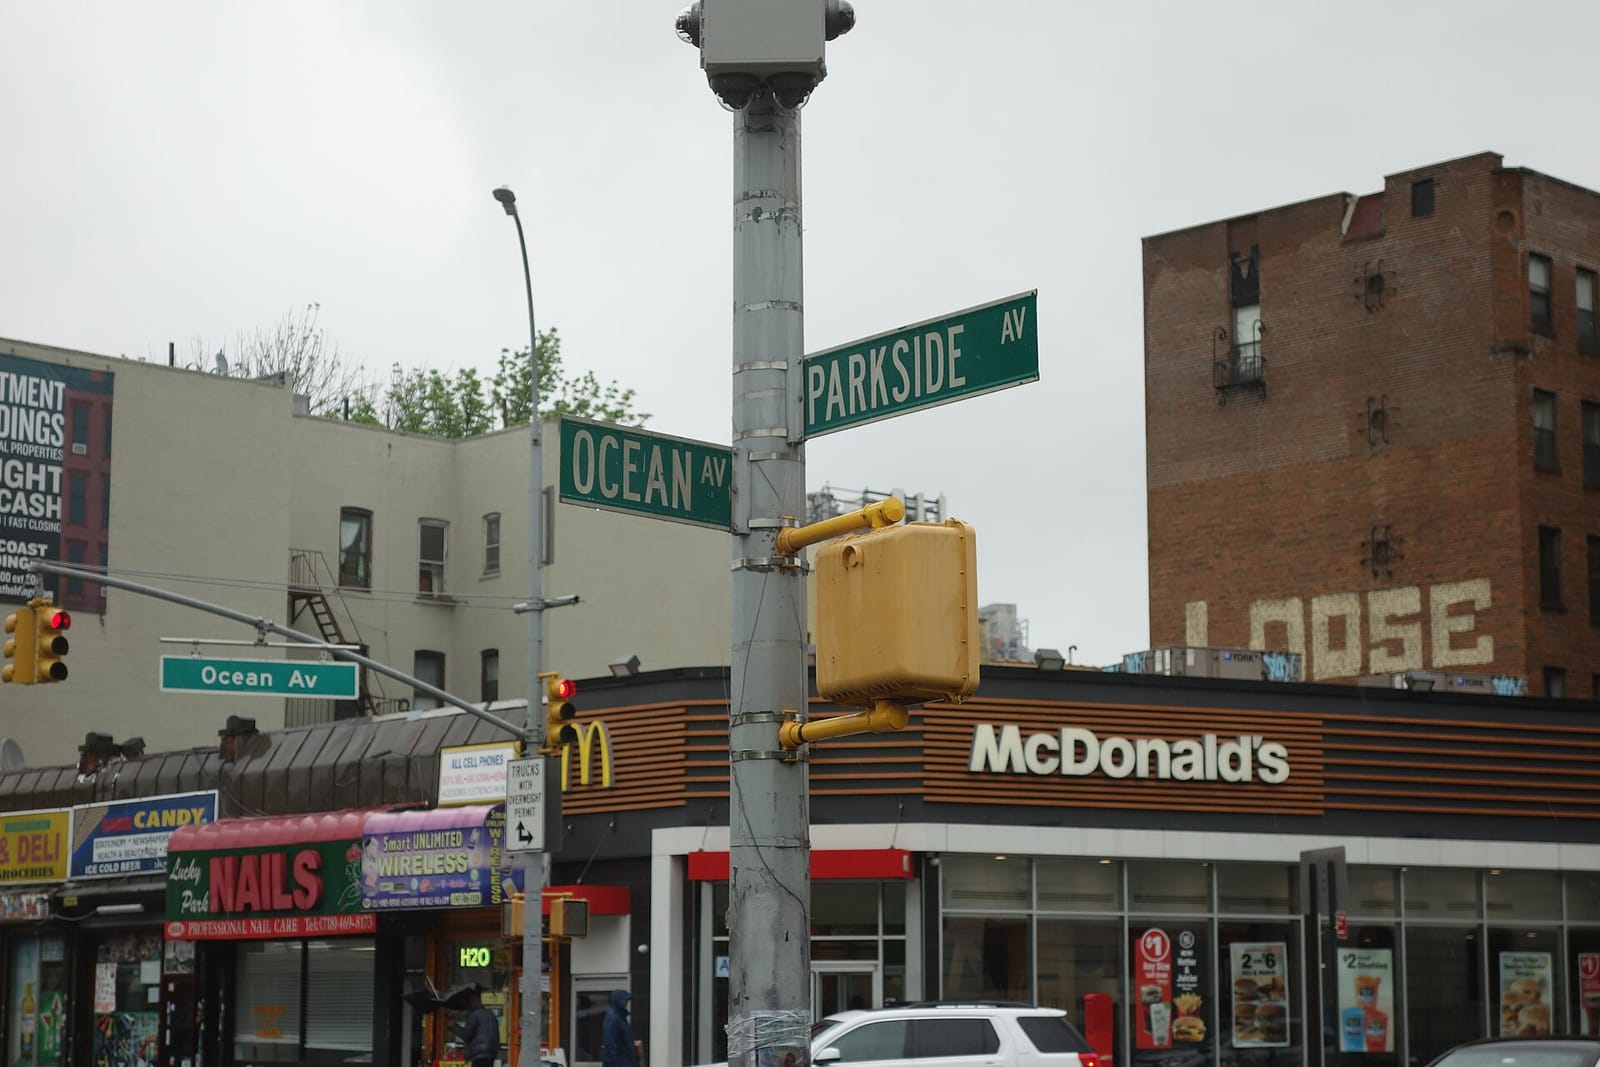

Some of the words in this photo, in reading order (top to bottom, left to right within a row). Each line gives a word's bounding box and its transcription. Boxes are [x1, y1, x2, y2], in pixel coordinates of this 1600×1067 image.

[808, 324, 966, 425] PARKSIDE
[1000, 306, 1026, 345] AV
[0, 371, 66, 411] TMENT
[0, 403, 65, 448] DINGS
[11, 442, 64, 462] PROPERTIES
[0, 458, 63, 494] GHT
[572, 429, 692, 512] OCEAN
[700, 455, 726, 488] AV
[0, 487, 62, 520] CASH
[9, 516, 27, 530] FAST
[0, 539, 48, 558] COAST
[0, 554, 33, 571] ING
[201, 665, 273, 687] Ocean
[287, 670, 318, 689] Av
[451, 758, 462, 769] ALL
[463, 756, 477, 768] CELL
[479, 754, 504, 767] PHONES
[969, 723, 1290, 784] McDonald's
[512, 763, 540, 777] TRUCKS
[519, 780, 532, 790] WITH
[508, 792, 541, 805] OVERWEIGHT
[133, 807, 205, 829] CANDY
[514, 807, 536, 818] PERMIT
[18, 832, 60, 864] DELI
[383, 836, 411, 853] Smart
[413, 830, 463, 850] UNLIMITED
[0, 866, 54, 880] ROCERIES
[85, 864, 98, 875] ICE
[99, 862, 119, 873] COLD
[120, 861, 141, 872] BEER
[169, 857, 202, 886] Lucky
[379, 851, 468, 877] WIRELESS
[488, 827, 503, 905] WIRELESS
[208, 849, 323, 914] NAILS
[181, 889, 209, 914] Park
[188, 920, 248, 936] PROFESSIONAL
[250, 919, 271, 934] NAIL
[273, 918, 298, 933] CARE
[1145, 935, 1162, 956] $1
[460, 947, 490, 967] H2O
[1241, 953, 1252, 969] 2
[1343, 953, 1357, 969] $2
